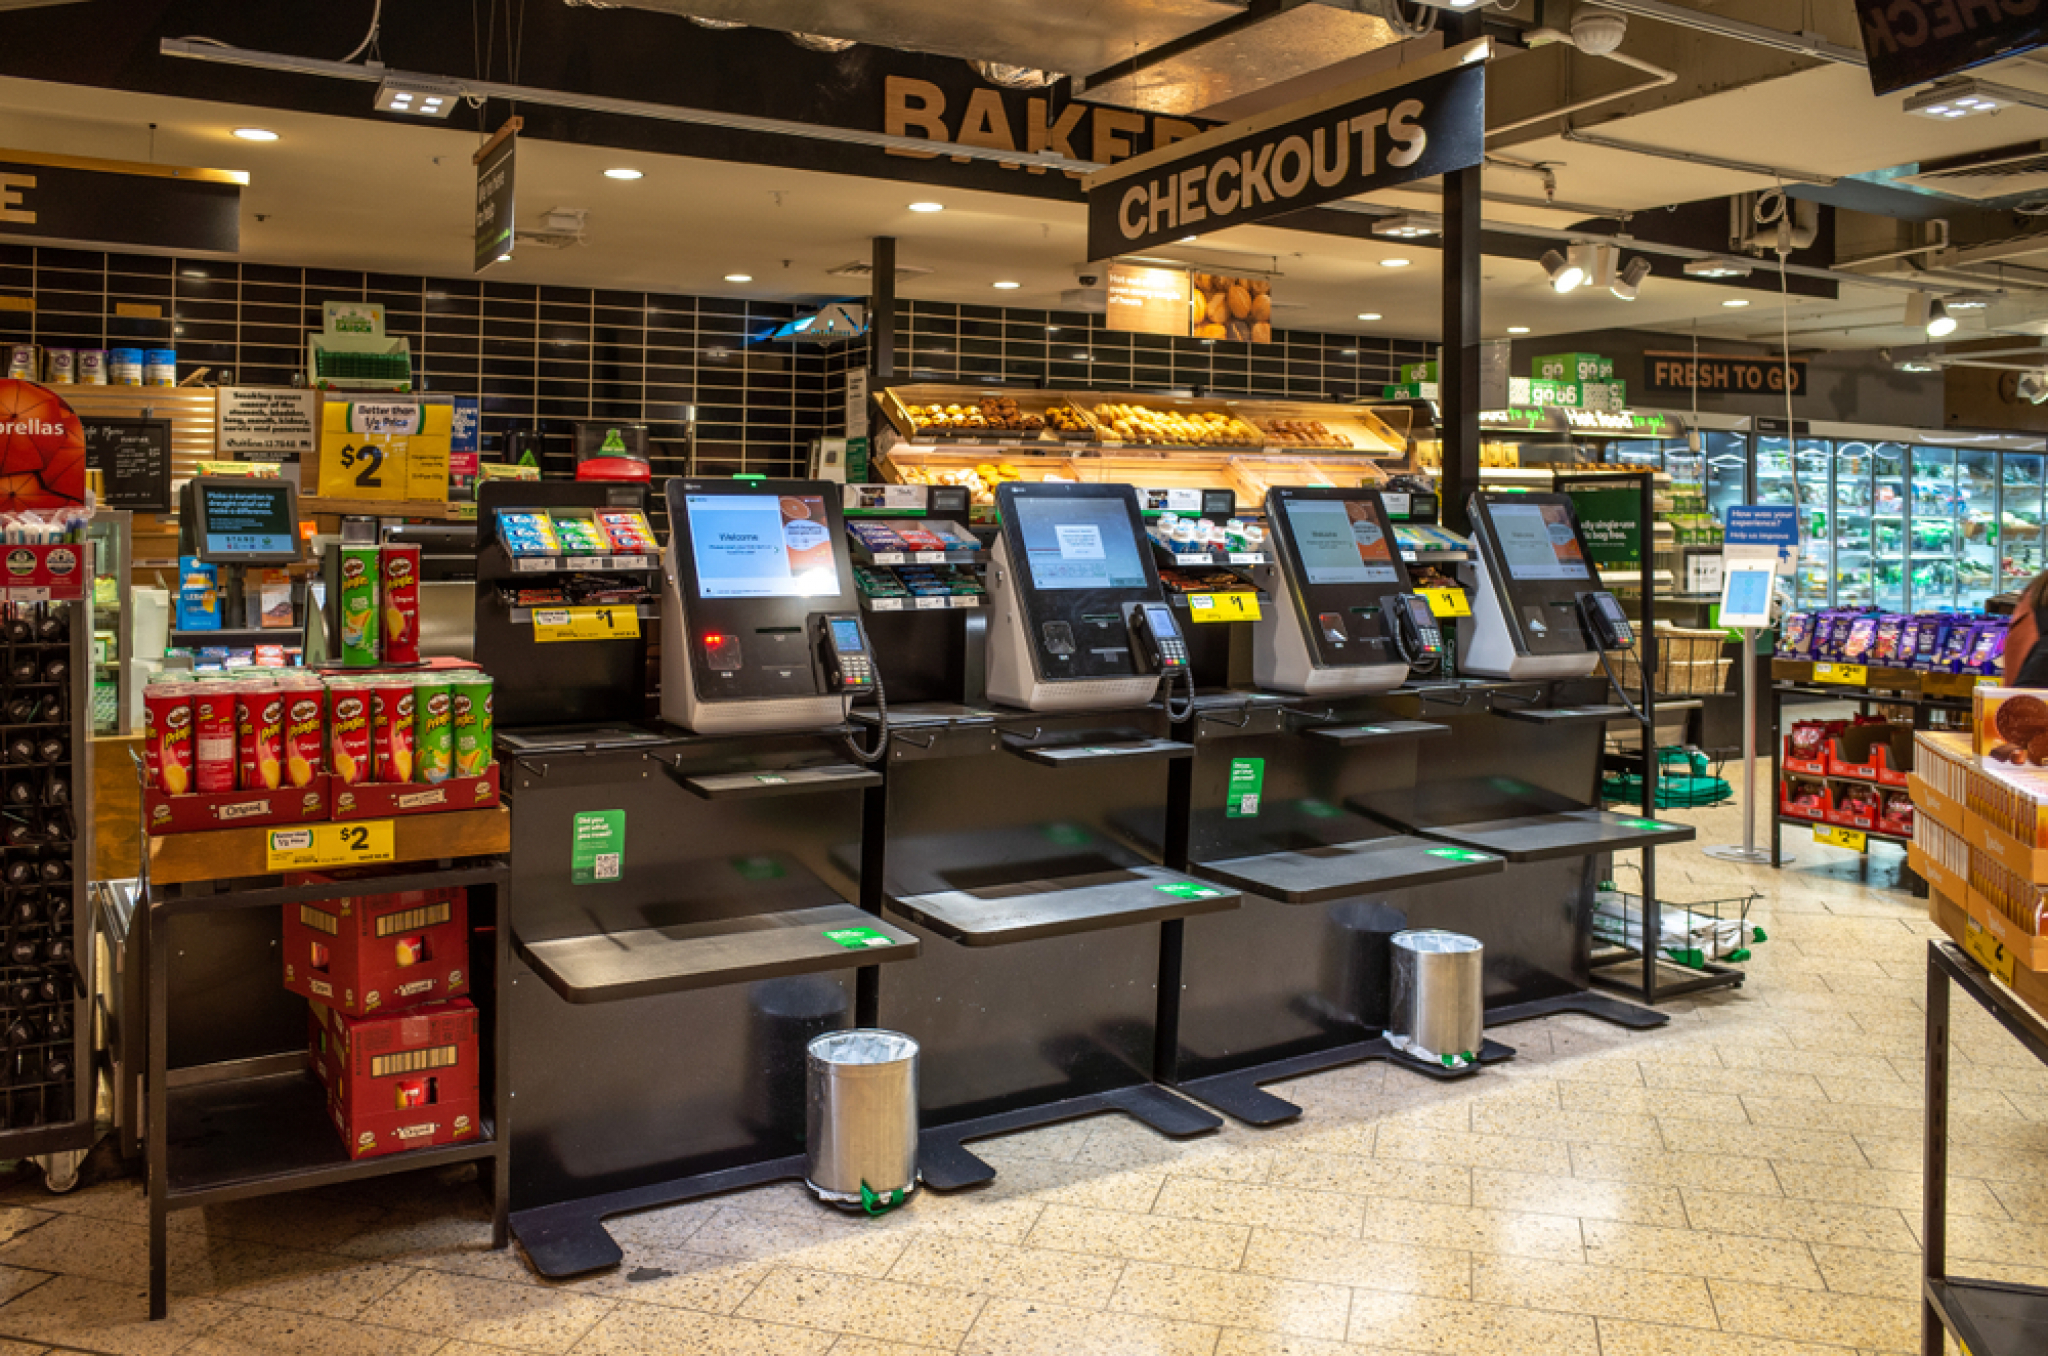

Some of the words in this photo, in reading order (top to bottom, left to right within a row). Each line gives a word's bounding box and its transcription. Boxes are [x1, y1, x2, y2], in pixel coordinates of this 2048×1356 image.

[1118, 99, 1427, 240] CHECKOUTS
[0, 171, 37, 224] E
[1541, 362, 1564, 382] go
[1577, 361, 1598, 381] go
[1655, 361, 1729, 389] FRESH
[1732, 365, 1763, 390] TO
[1766, 366, 1799, 391] GO
[1531, 386, 1555, 407] go
[357, 404, 390, 415] Better
[390, 405, 417, 416] than
[382, 417, 408, 427] Price
[339, 443, 384, 488] $2
[1730, 519, 1783, 529] experience?
[1731, 509, 1751, 519] How
[1754, 511, 1773, 519] was
[1774, 511, 1795, 520] your
[718, 532, 759, 542] Welcome
[1730, 531, 1747, 541] Help
[1759, 533, 1791, 542] improve
[596, 609, 615, 630] $1
[339, 825, 370, 851] $2
